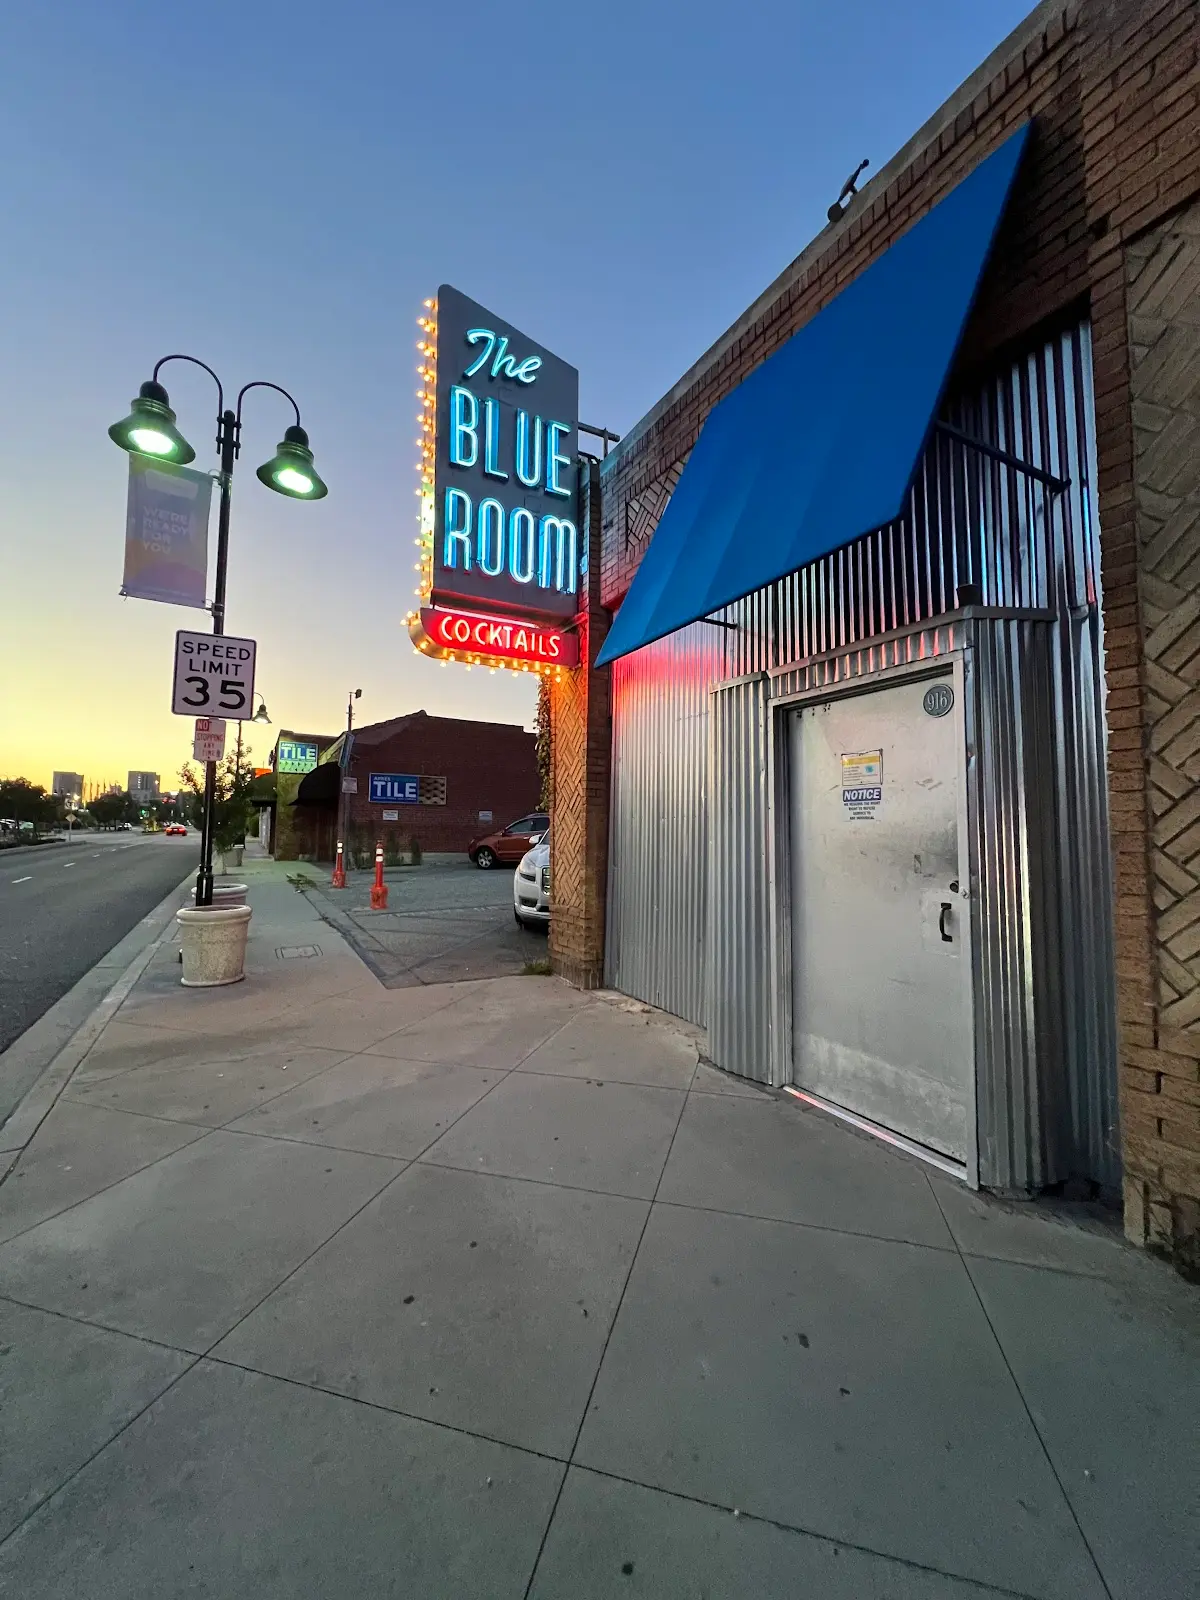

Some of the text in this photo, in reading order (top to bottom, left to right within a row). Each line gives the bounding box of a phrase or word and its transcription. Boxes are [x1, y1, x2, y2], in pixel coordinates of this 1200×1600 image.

[464, 328, 543, 384] The
[450, 385, 572, 496] BLUE
[143, 541, 172, 555] YOU
[443, 487, 577, 594] ROOM
[441, 616, 562, 657] COCKTAILS
[182, 641, 251, 660] SPEED
[189, 658, 242, 676] LIMIT
[182, 676, 246, 709] 35
[927, 690, 948, 711] 916
[197, 720, 208, 730] NO
[197, 733, 224, 742] STOPPING
[281, 746, 316, 760] TILE
[373, 780, 417, 797] TILE
[844, 789, 880, 800] NOTICE
